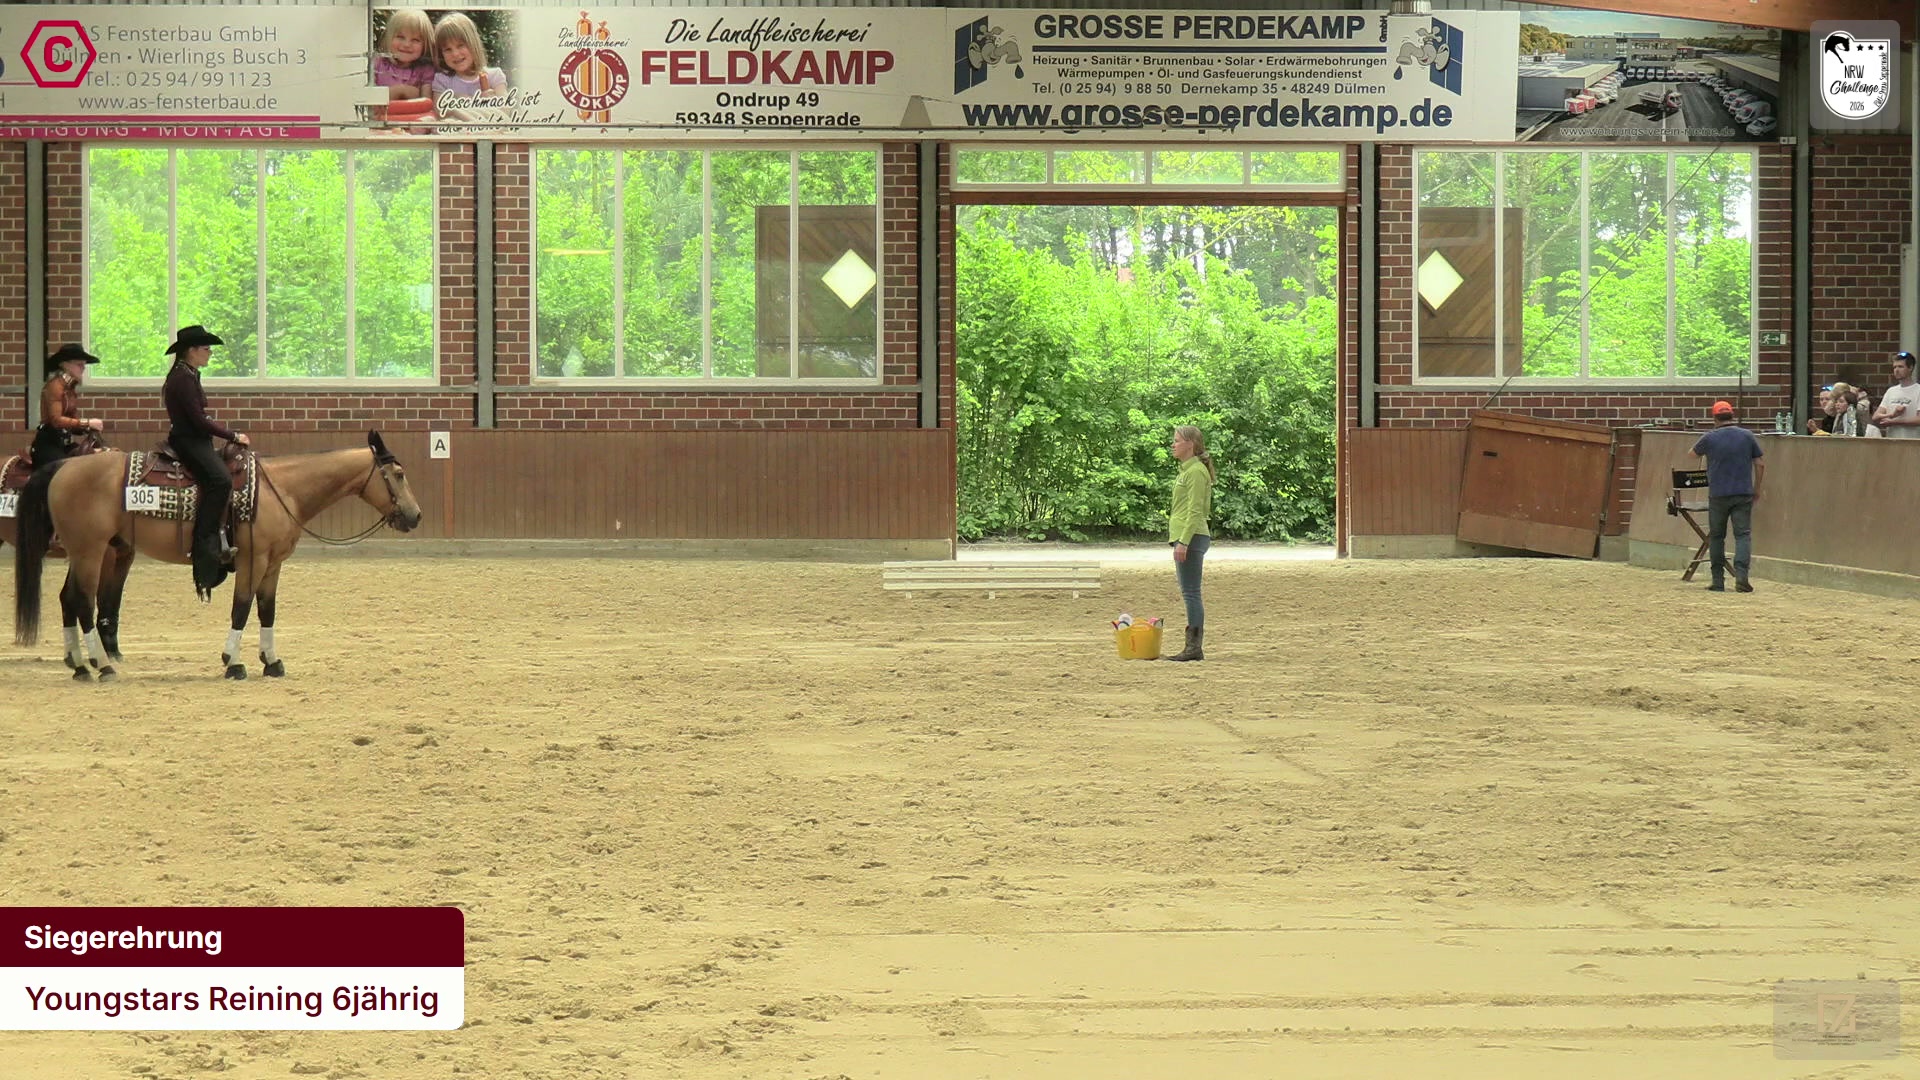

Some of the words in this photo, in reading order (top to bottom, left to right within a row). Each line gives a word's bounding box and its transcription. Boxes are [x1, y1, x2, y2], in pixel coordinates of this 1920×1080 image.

[107, 25, 212, 42] Fensterbau
[219, 25, 277, 42] GmbH
[558, 27, 575, 39] Die
[665, 18, 700, 43] Die
[706, 17, 871, 51] Landfleischerei
[1034, 14, 1164, 39] GROSSE
[1173, 15, 1365, 40] PERDEKAMP
[1379, 15, 1388, 43] GmbH
[558, 37, 630, 51] Landfleischerei
[138, 48, 226, 68] Wierlings
[233, 48, 289, 64] Busch
[296, 49, 307, 64] 3
[1033, 56, 1080, 67] Heizung
[1091, 55, 1132, 65] Sanitär
[1143, 56, 1213, 66] Brunnenbau
[1225, 56, 1255, 66] Solar
[1266, 56, 1387, 68] Erdwärmebohrungen
[641, 50, 895, 85] FELDKAMP
[1057, 68, 1145, 80] Wärmepumpen
[1157, 67, 1174, 78] Öl-
[1177, 68, 1199, 78] und
[1203, 69, 1362, 80] Gasfeuerungskundendienst
[86, 71, 120, 87] Tel.:
[560, 73, 627, 109] FELDKAMP
[1032, 83, 1055, 94] Tel.
[1181, 83, 1258, 98] Dernekamp
[1262, 83, 1278, 94] 35
[1290, 83, 1330, 95] 48249
[1334, 82, 1386, 95] Dülmen
[78, 94, 277, 110] www.as-fensterbau.de
[438, 88, 517, 115] Geschmack
[521, 91, 542, 106] ist
[716, 92, 790, 110] Ondrup
[796, 92, 819, 107] 49
[675, 112, 735, 125] 59348
[740, 111, 861, 126] Seppenrade
[962, 98, 1453, 134] www.grosse-perdekamp.de
[434, 438, 446, 451] A
[0, 495, 15, 511] 74
[131, 490, 154, 505] 305
